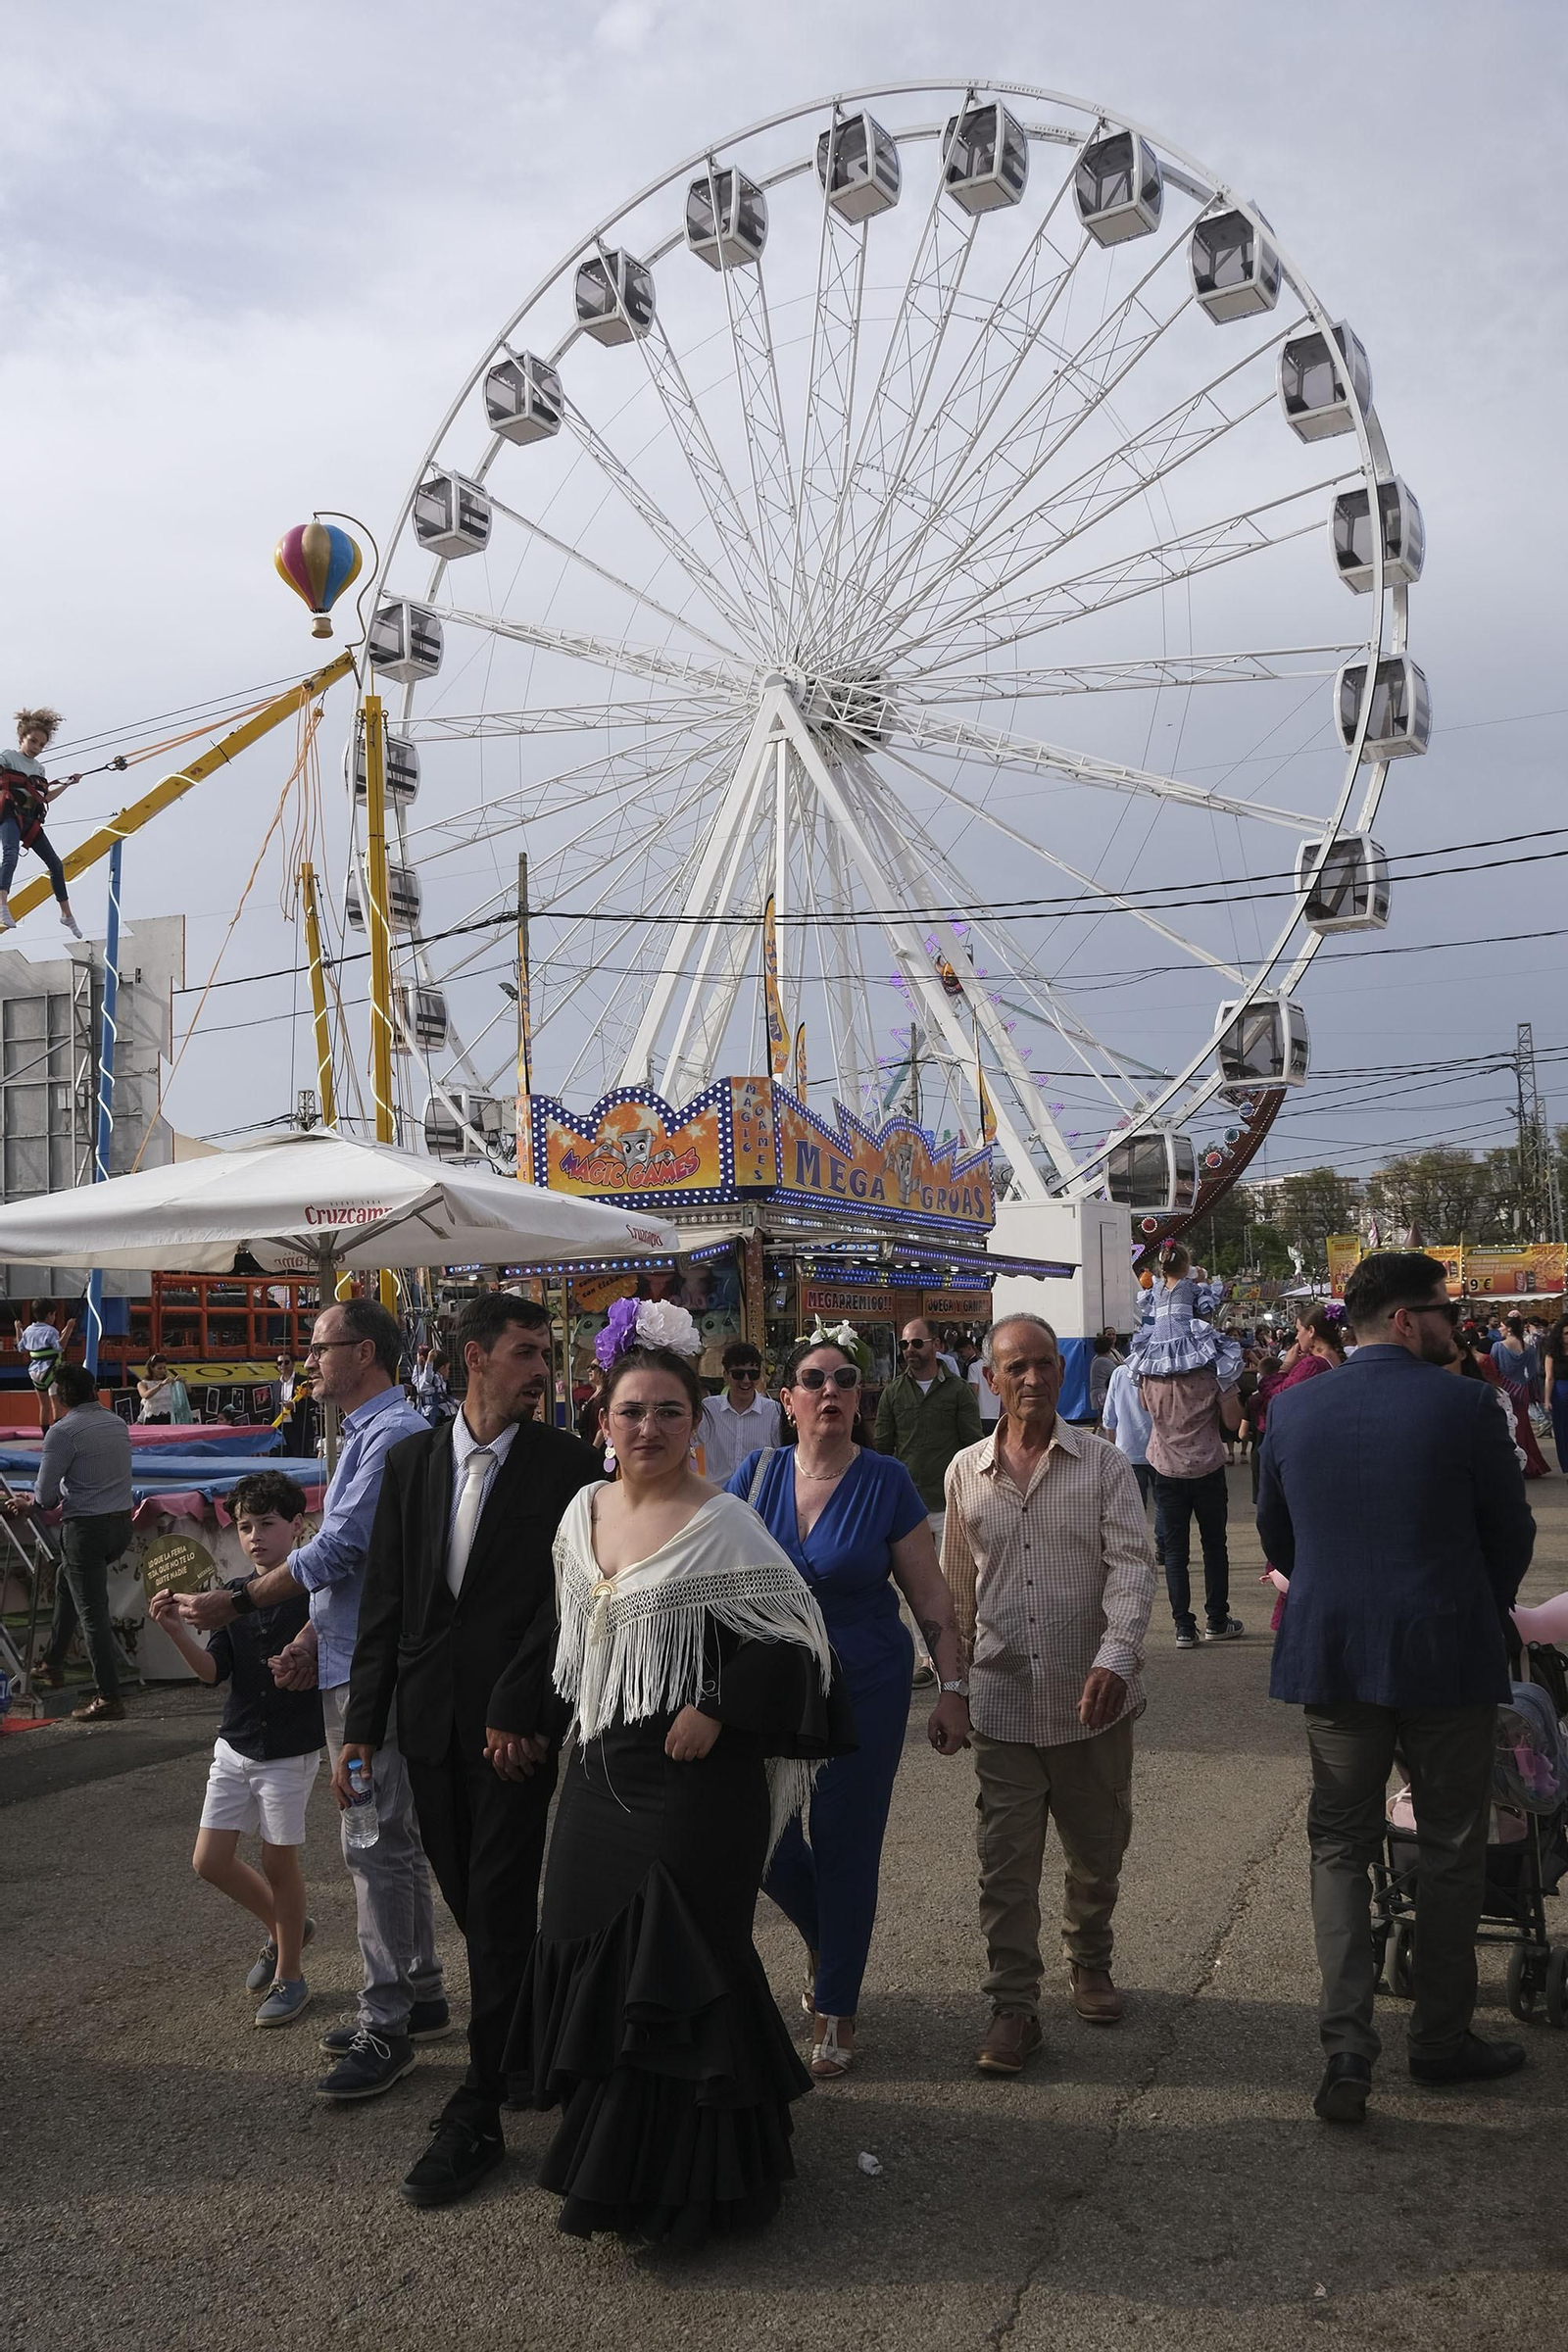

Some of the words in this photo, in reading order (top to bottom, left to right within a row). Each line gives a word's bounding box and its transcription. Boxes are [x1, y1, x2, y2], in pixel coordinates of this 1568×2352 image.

[745, 1084, 757, 1153] MAGIC
[754, 1104, 768, 1180] GAMES
[560, 1149, 625, 1188] MAGIC
[627, 1147, 700, 1189] GAMES
[793, 1139, 886, 1201] MEGA
[920, 1185, 986, 1219] GRUAS
[1470, 1279, 1478, 1291] 9
[164, 1552, 172, 1561] LA
[171, 1545, 187, 1557] FERIA
[170, 1559, 179, 1570] NO
[179, 1555, 187, 1565] TE
[186, 1552, 195, 1562] LO
[170, 1565, 187, 1579] NADIE
